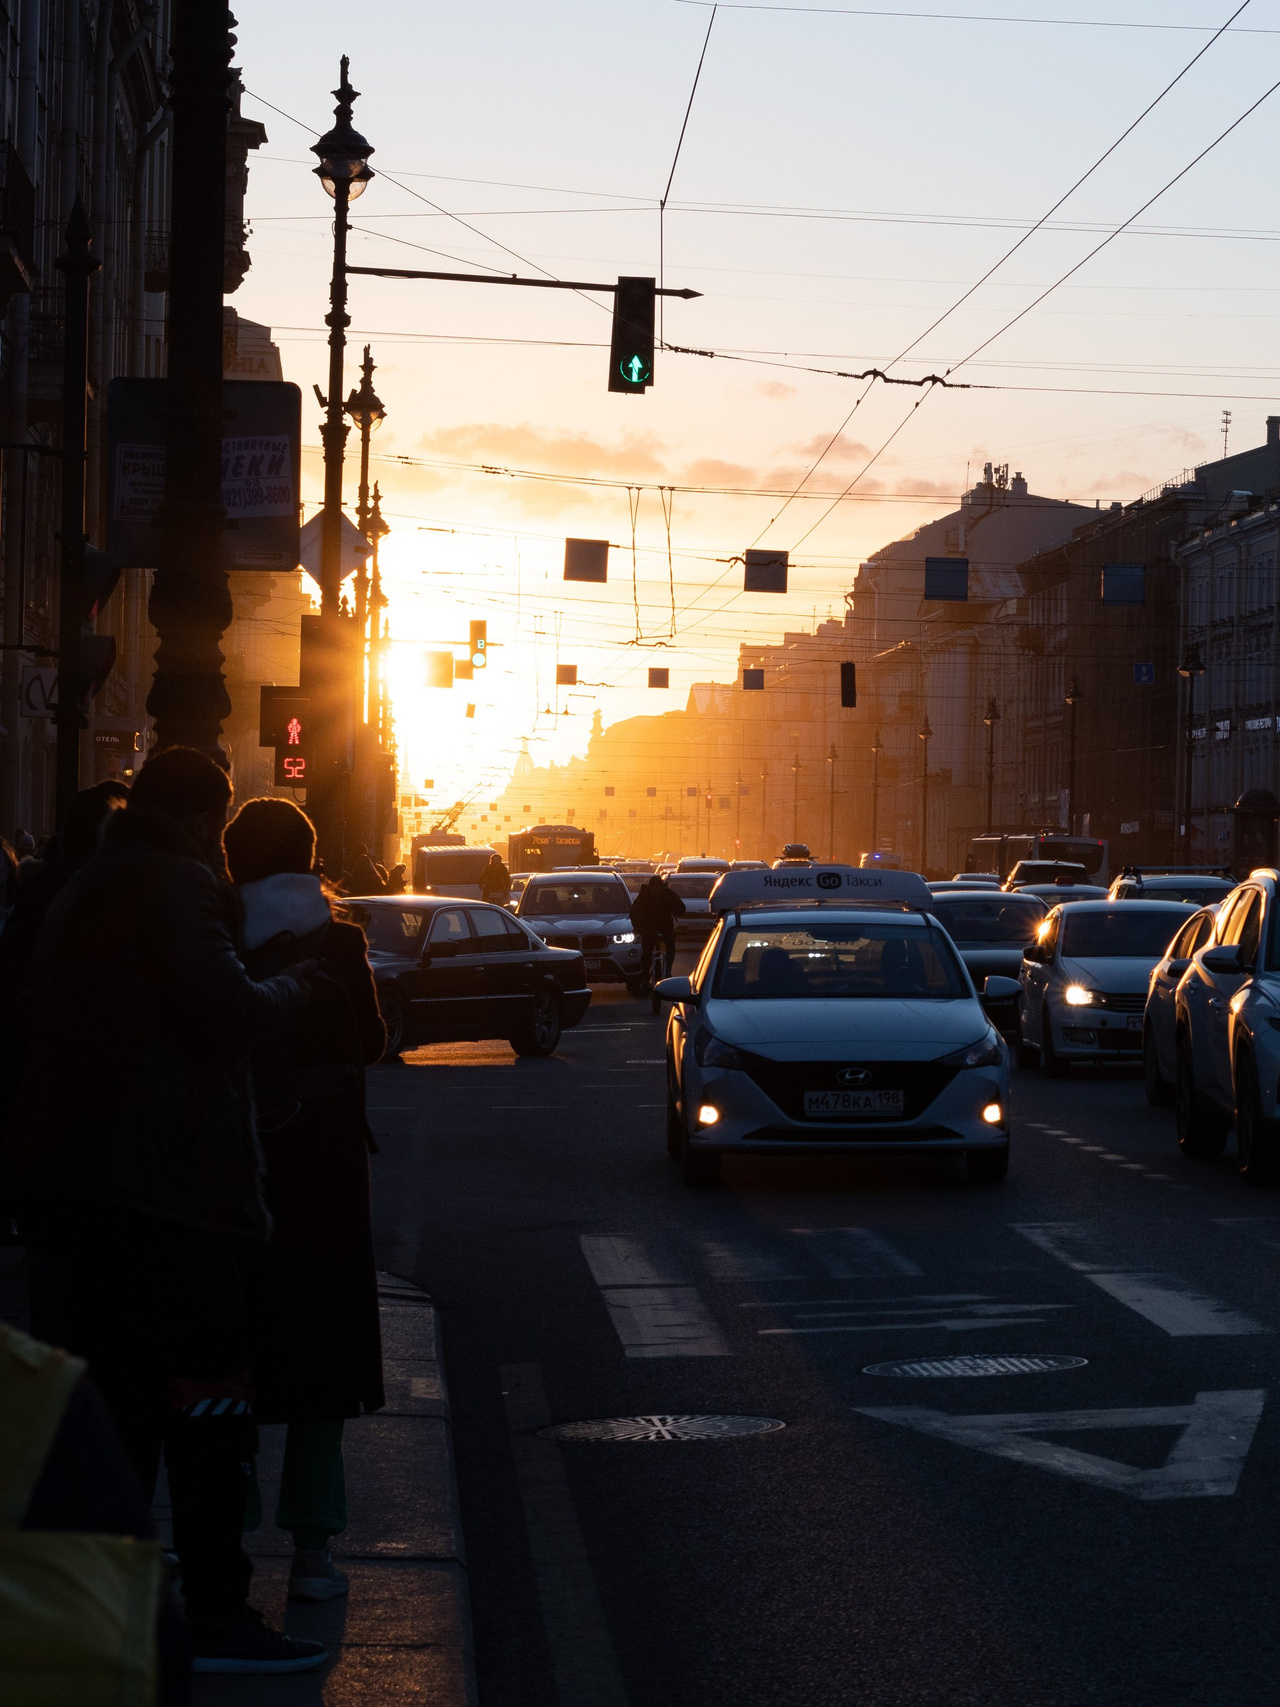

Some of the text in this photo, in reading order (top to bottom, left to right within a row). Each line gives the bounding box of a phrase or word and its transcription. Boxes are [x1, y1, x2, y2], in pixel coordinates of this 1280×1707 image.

[95, 735, 120, 744] ОТЕЛЬ
[284, 758, 306, 778] 52
[763, 873, 882, 887] Яндекс Go Такси
[807, 1093, 873, 1109] М478КА
[876, 1092, 899, 1105] 198
